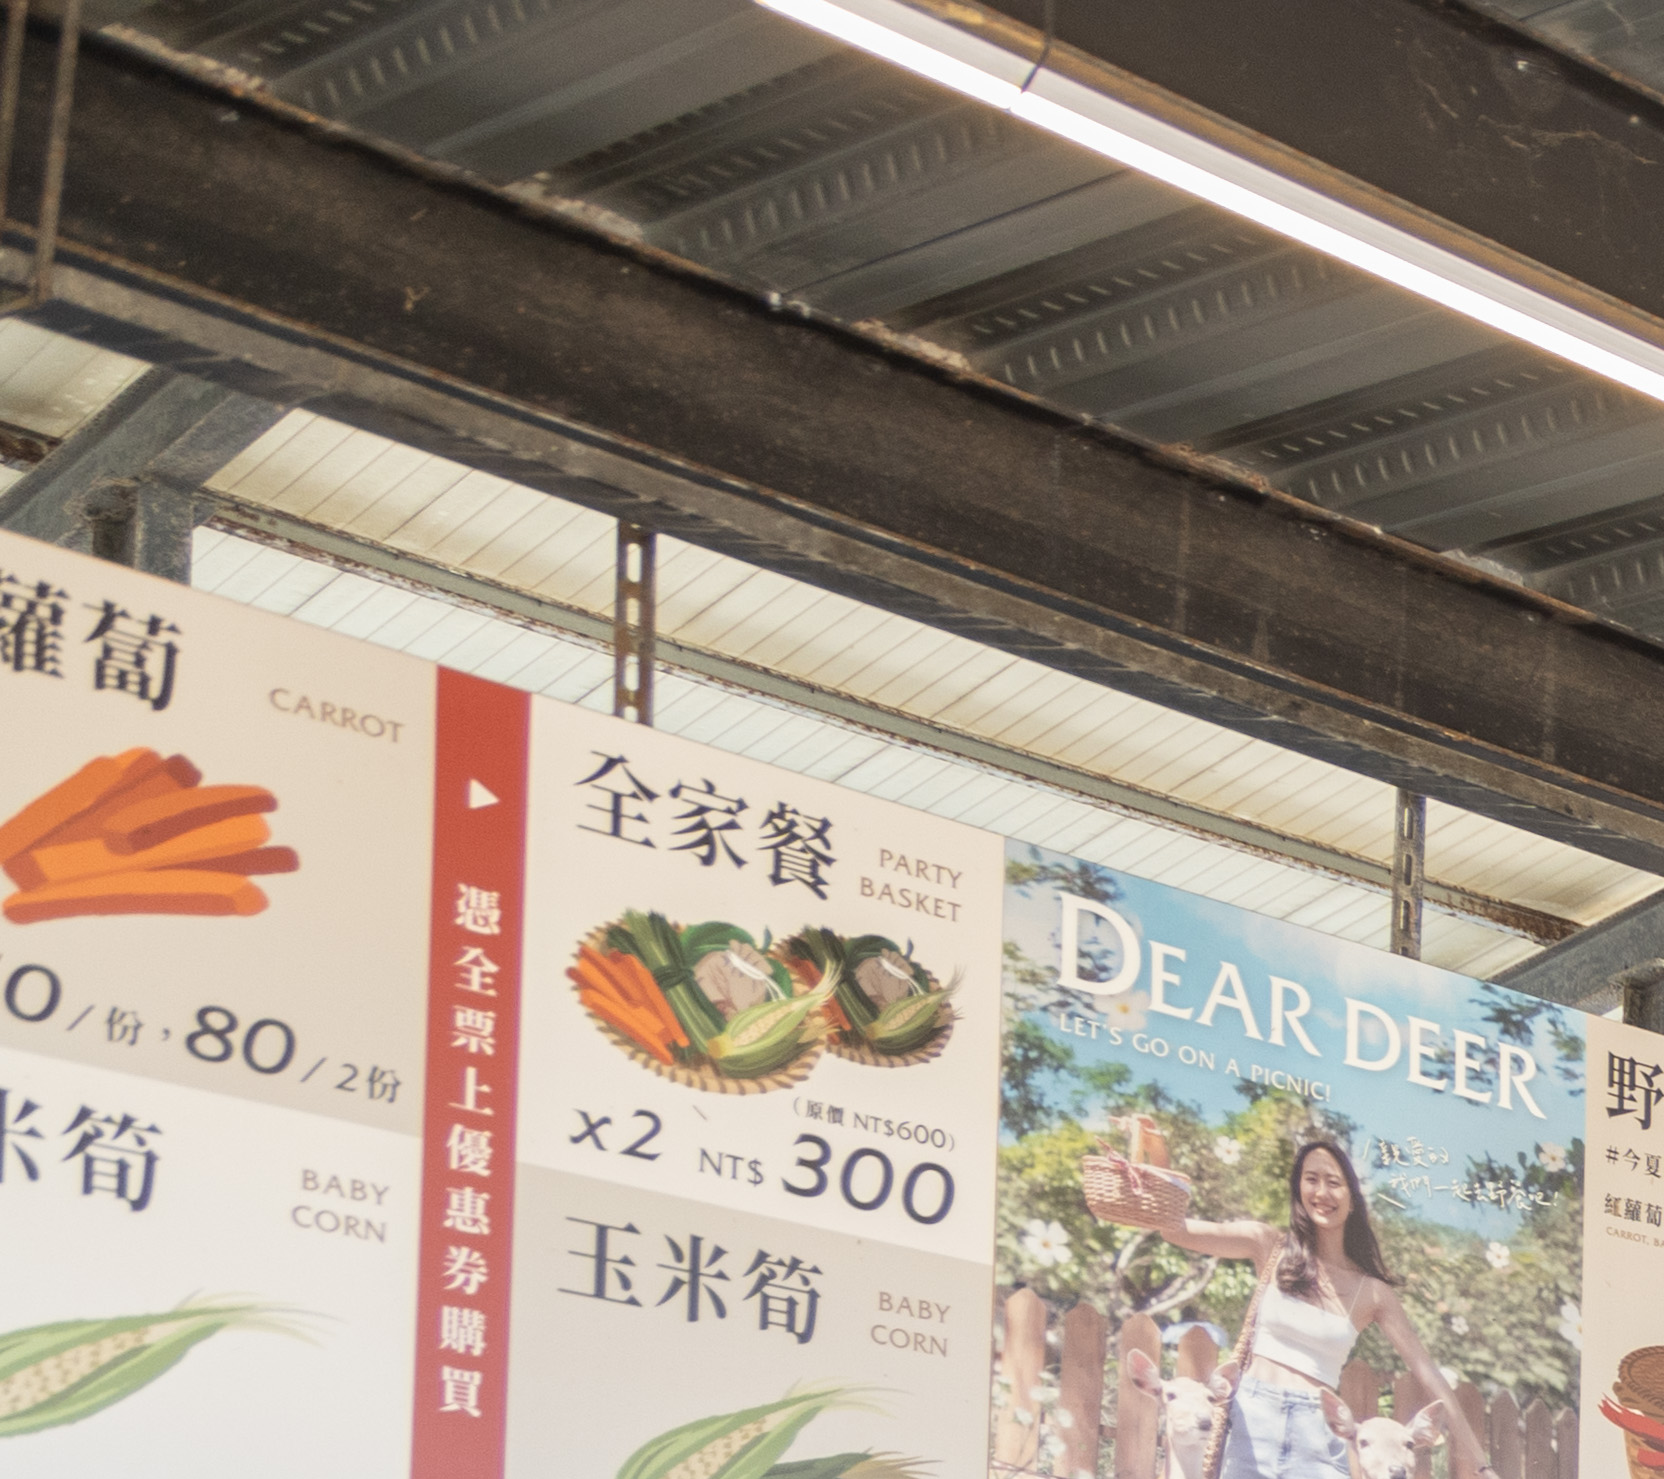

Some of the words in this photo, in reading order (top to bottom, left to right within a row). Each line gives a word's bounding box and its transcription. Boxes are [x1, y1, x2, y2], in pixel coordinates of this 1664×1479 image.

[268, 687, 406, 744] CARROT
[573, 750, 838, 901] 全家餐
[879, 847, 963, 890] PARTY
[859, 875, 963, 923] BASKET
[1055, 889, 1323, 1058] DEAR
[1342, 995, 1549, 1122] DEER
[1058, 1011, 1123, 1048] LET'S
[1131, 1031, 1171, 1059] GO
[1177, 1044, 1217, 1073] ON
[1223, 1057, 1243, 1079] A
[1250, 1063, 1333, 1104] PICNIC!
[438, 882, 502, 1418] 憑全票上優惠券購買
[301, 1168, 390, 1206] BABY
[697, 1147, 765, 1188] NT$
[780, 1132, 957, 1226] 300
[290, 1204, 388, 1244] CORN
[556, 1211, 824, 1346] 玉米筍
[876, 1290, 952, 1325] BABY
[869, 1323, 949, 1359] CORN
